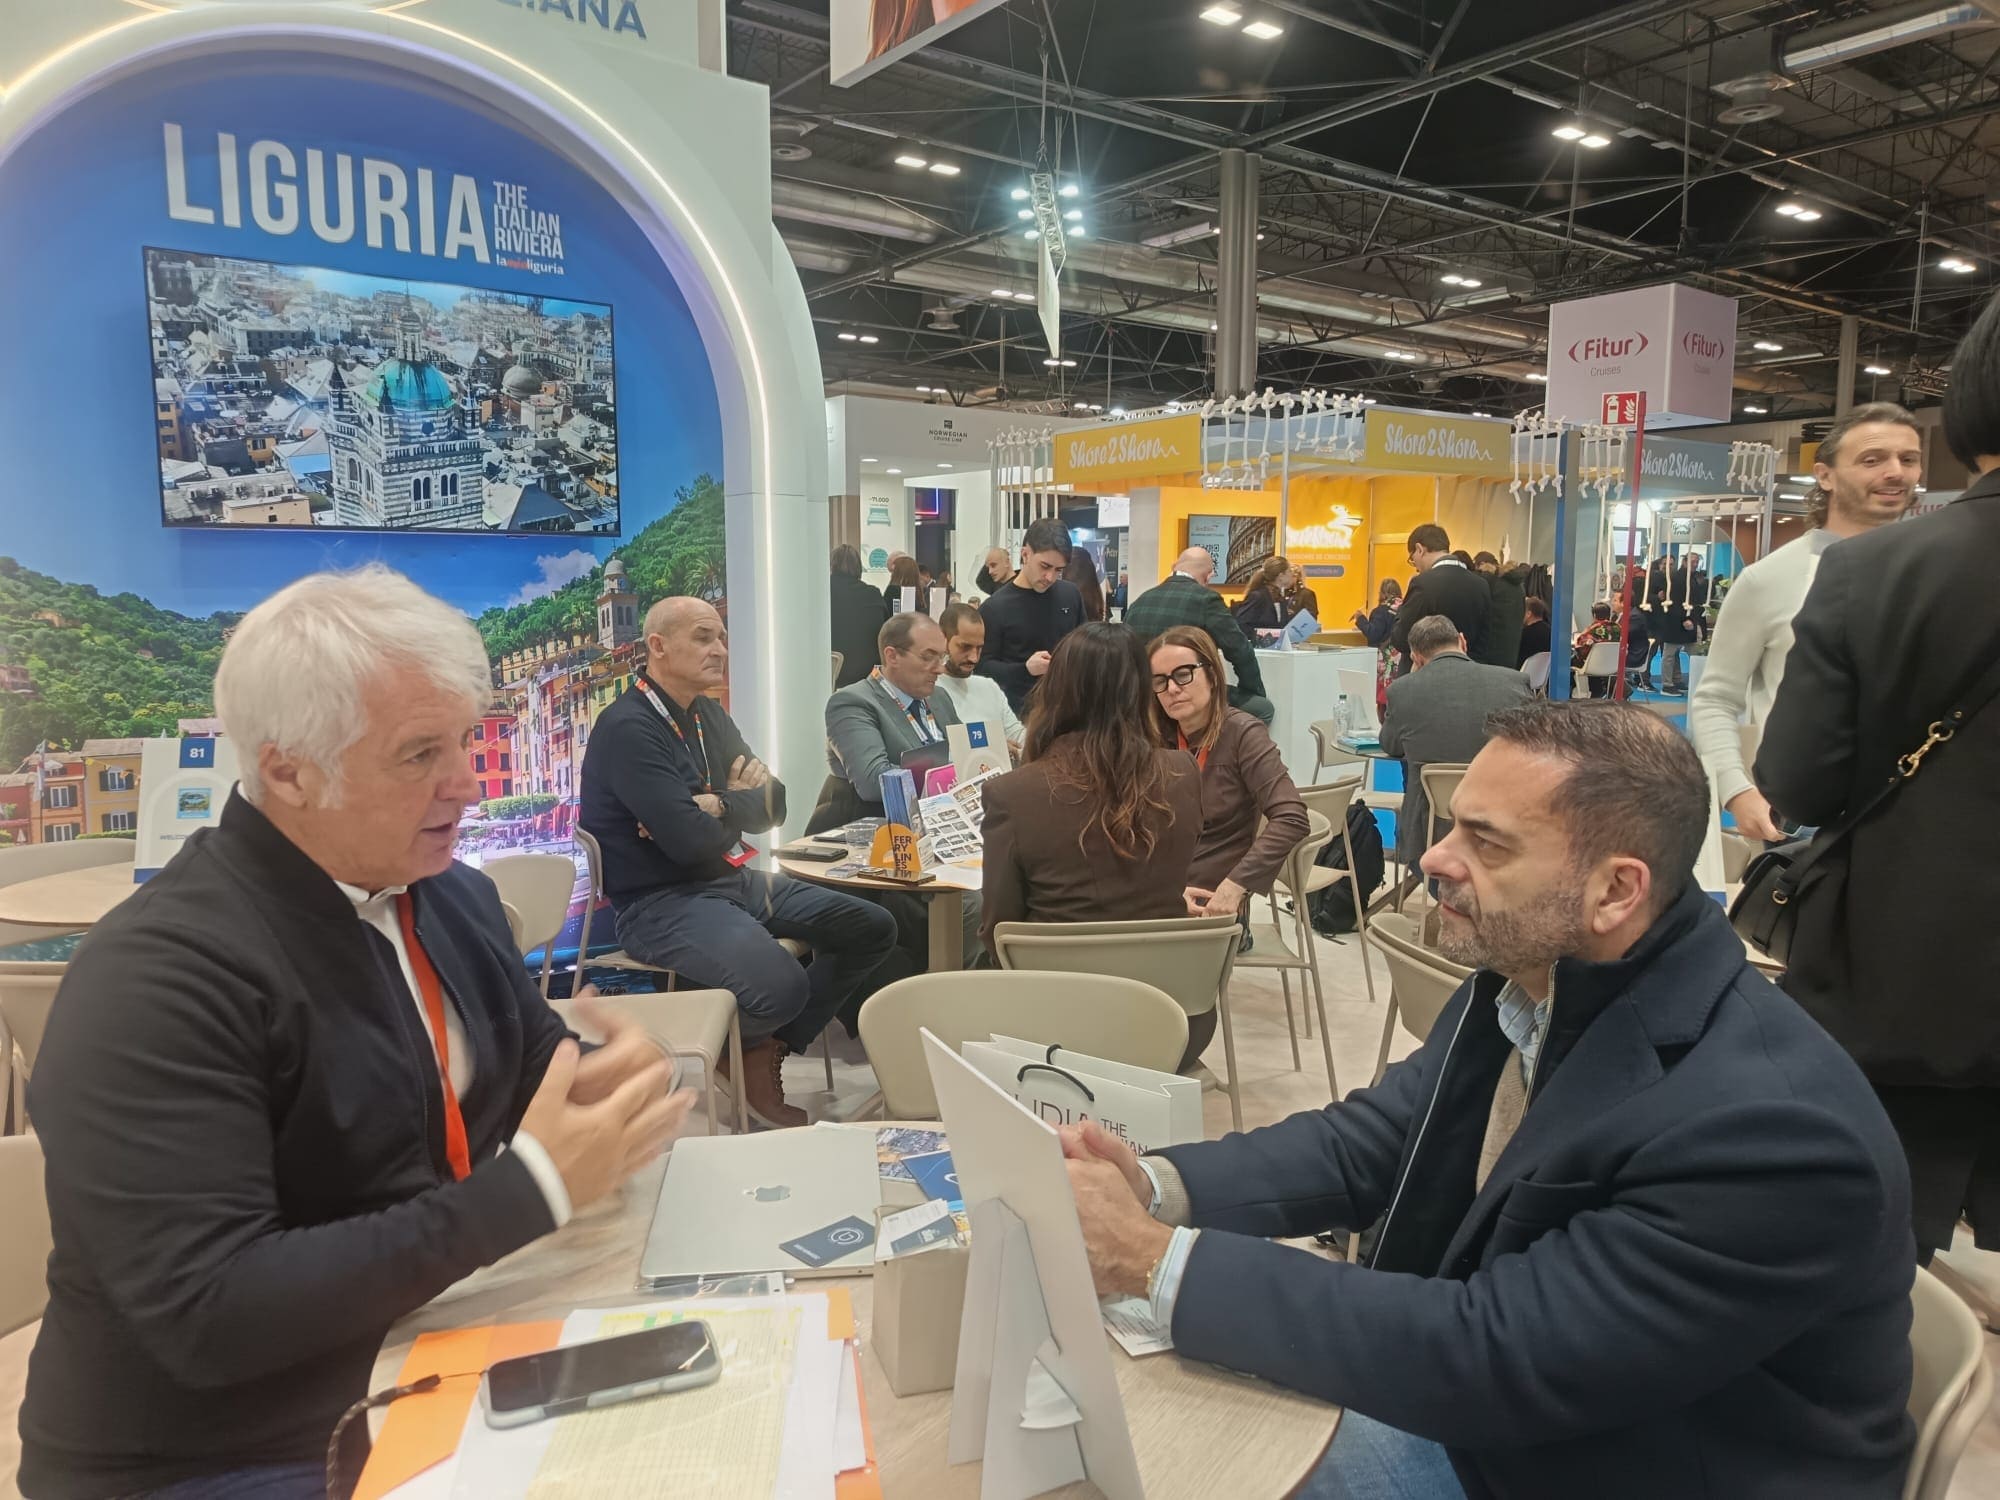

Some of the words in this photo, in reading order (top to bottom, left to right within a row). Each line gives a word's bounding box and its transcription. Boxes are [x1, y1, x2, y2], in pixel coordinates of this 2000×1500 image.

[163, 122, 491, 265] LIGURIA
[493, 180, 528, 210] THE
[493, 203, 561, 237] ITALIAN
[494, 227, 564, 260] RIVIERA
[1584, 337, 1634, 361] Fitur
[1691, 332, 1718, 359] Fitur
[1590, 365, 1622, 377] Cruises
[928, 429, 968, 438] NORWEGIAN
[1385, 423, 1493, 461] Shore2Shore
[1069, 433, 1180, 469] Shore2Shore
[972, 730, 983, 740] 79
[189, 748, 205, 759] 81
[894, 835, 912, 844] FER
[894, 843, 908, 852] RY
[1101, 1118, 1128, 1138] THE
